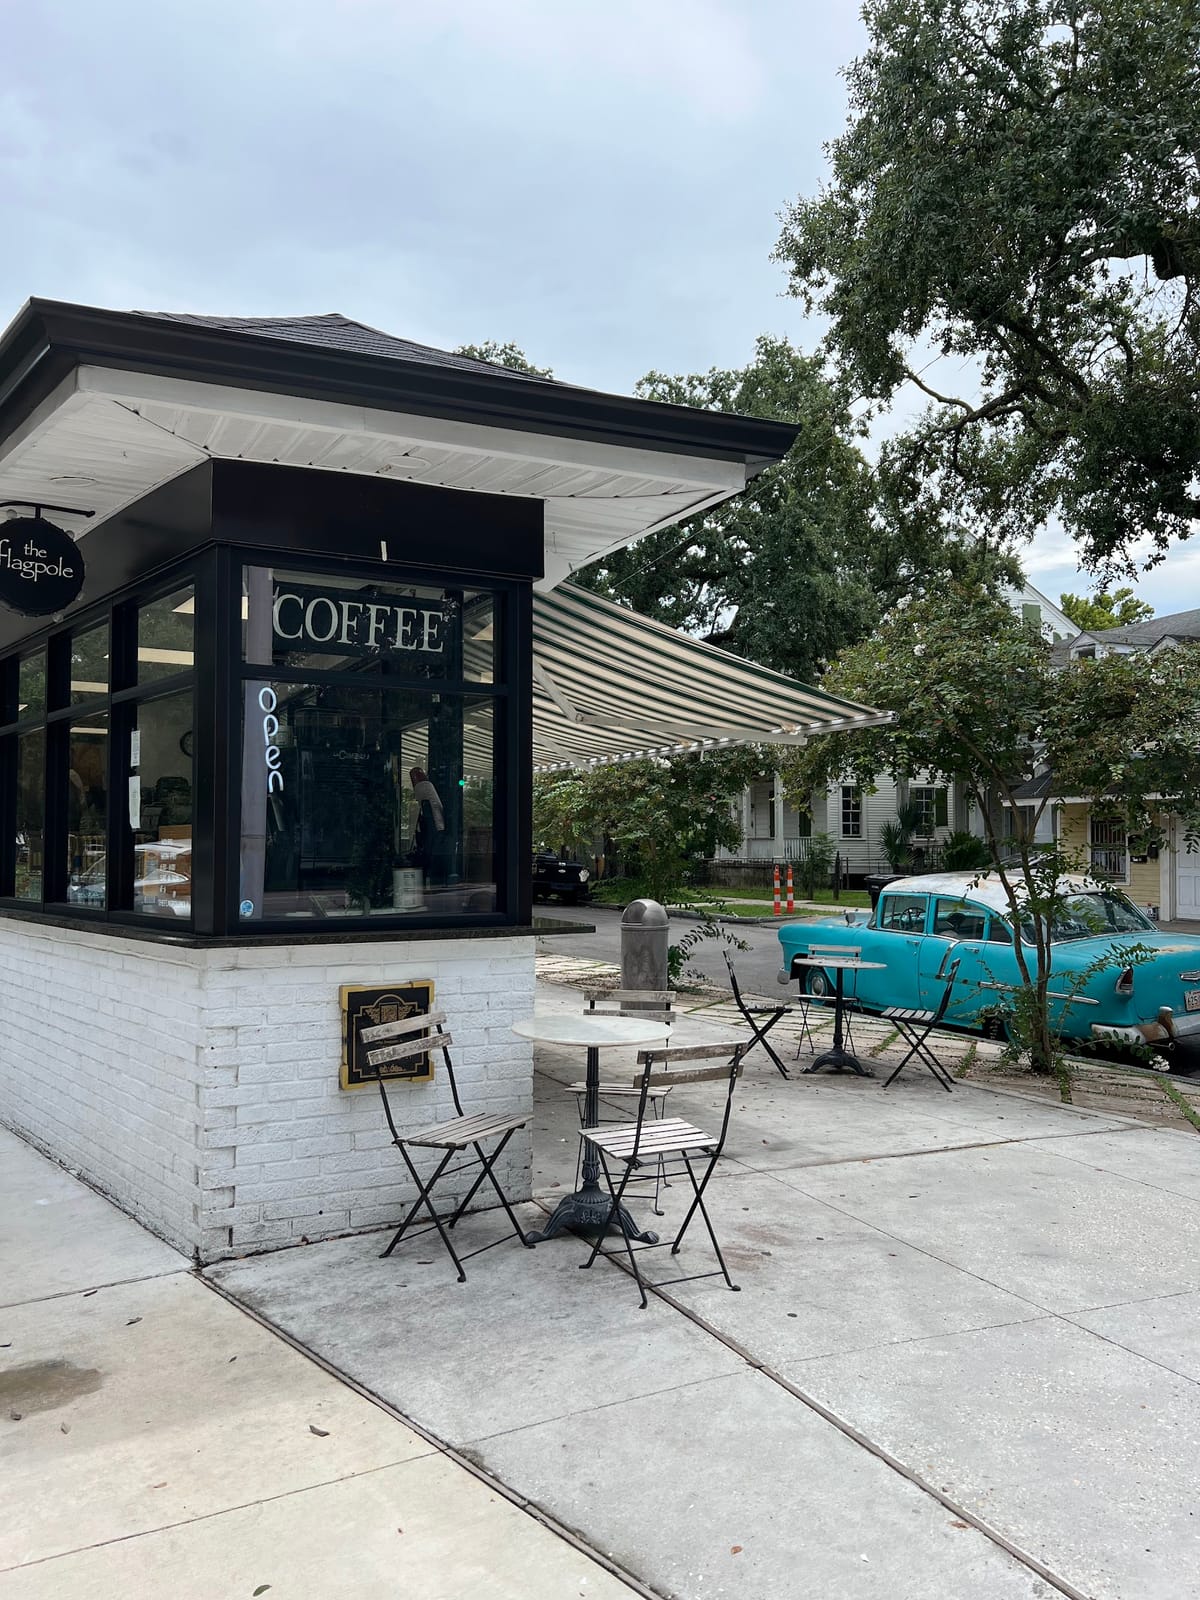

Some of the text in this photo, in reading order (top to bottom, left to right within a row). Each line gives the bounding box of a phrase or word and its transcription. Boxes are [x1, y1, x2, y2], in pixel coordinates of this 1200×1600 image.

[0, 539, 74, 582] flagpole
[24, 539, 48, 558] the
[272, 593, 444, 653] COFFEE
